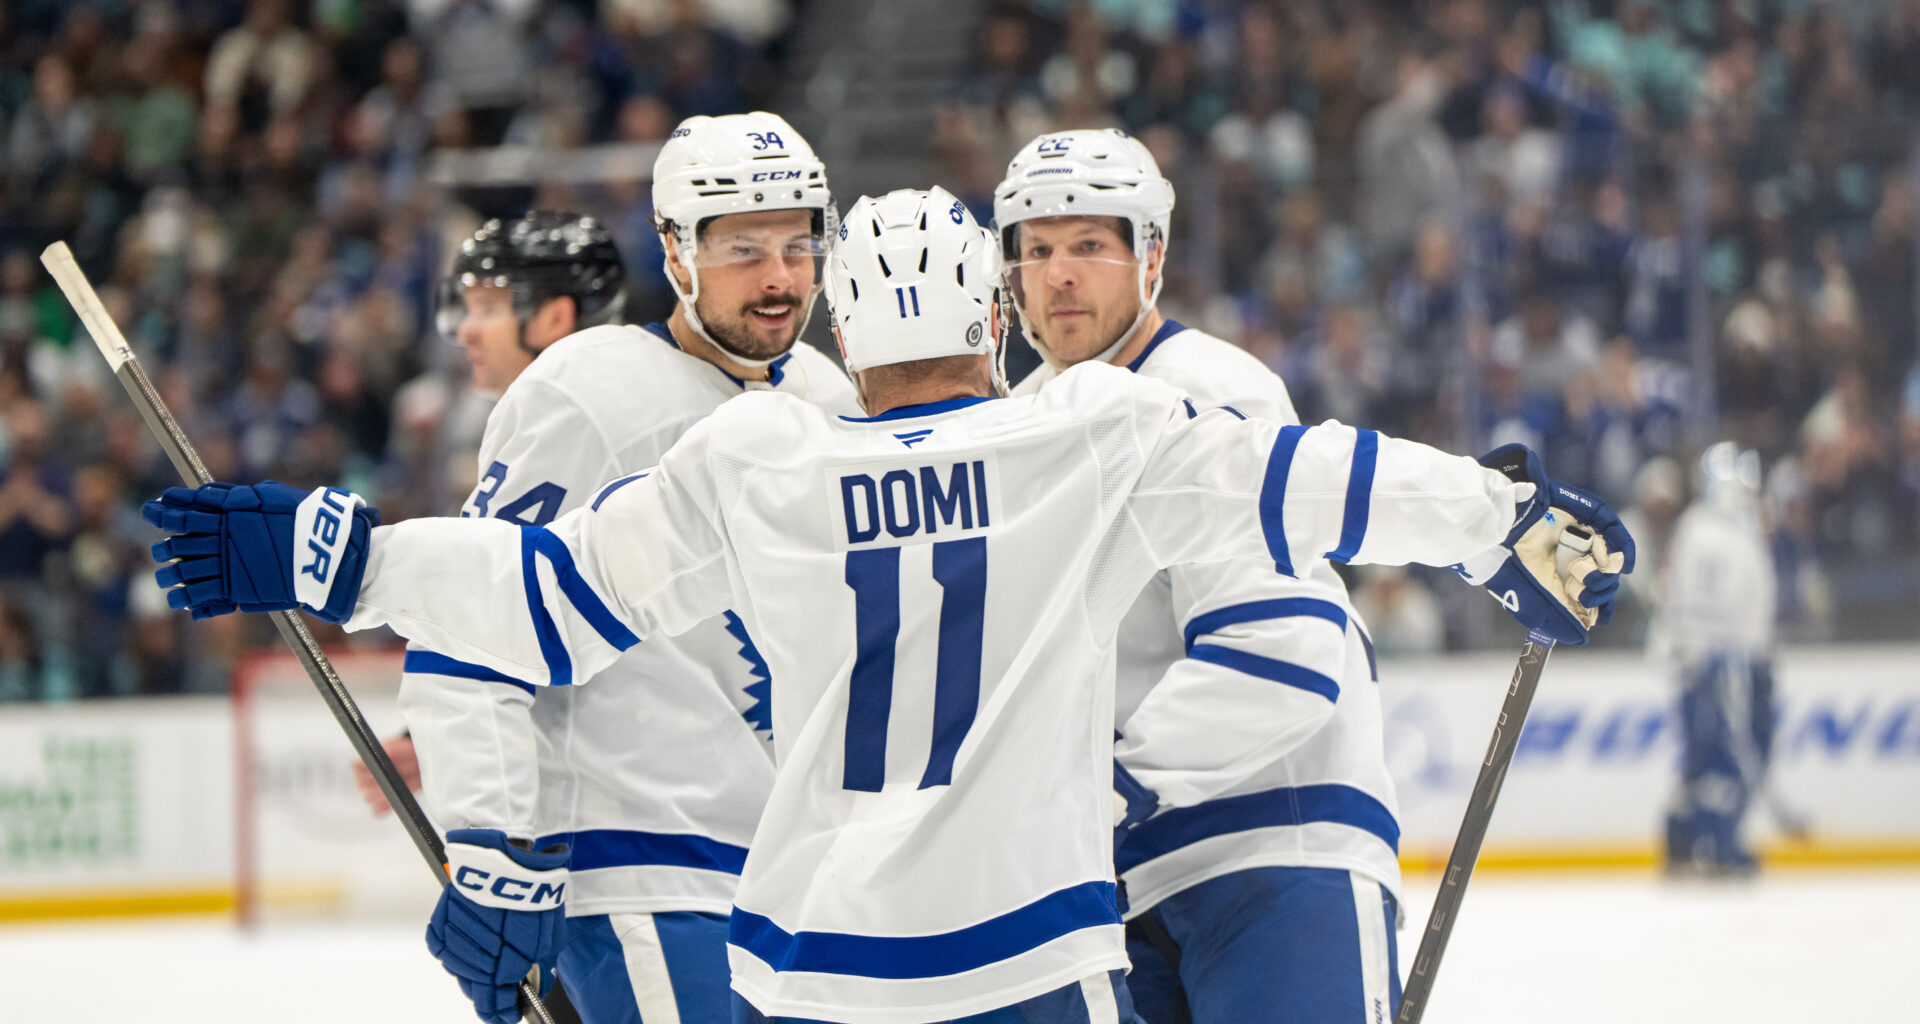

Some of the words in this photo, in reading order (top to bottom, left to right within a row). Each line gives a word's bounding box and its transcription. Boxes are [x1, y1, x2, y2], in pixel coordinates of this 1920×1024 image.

[746, 132, 784, 150] 34
[752, 170, 802, 182] CCM
[896, 286, 920, 318] 11
[461, 460, 568, 526] 34
[841, 460, 990, 544] DOMI
[843, 536, 988, 793] 11
[456, 865, 565, 905] CCM
